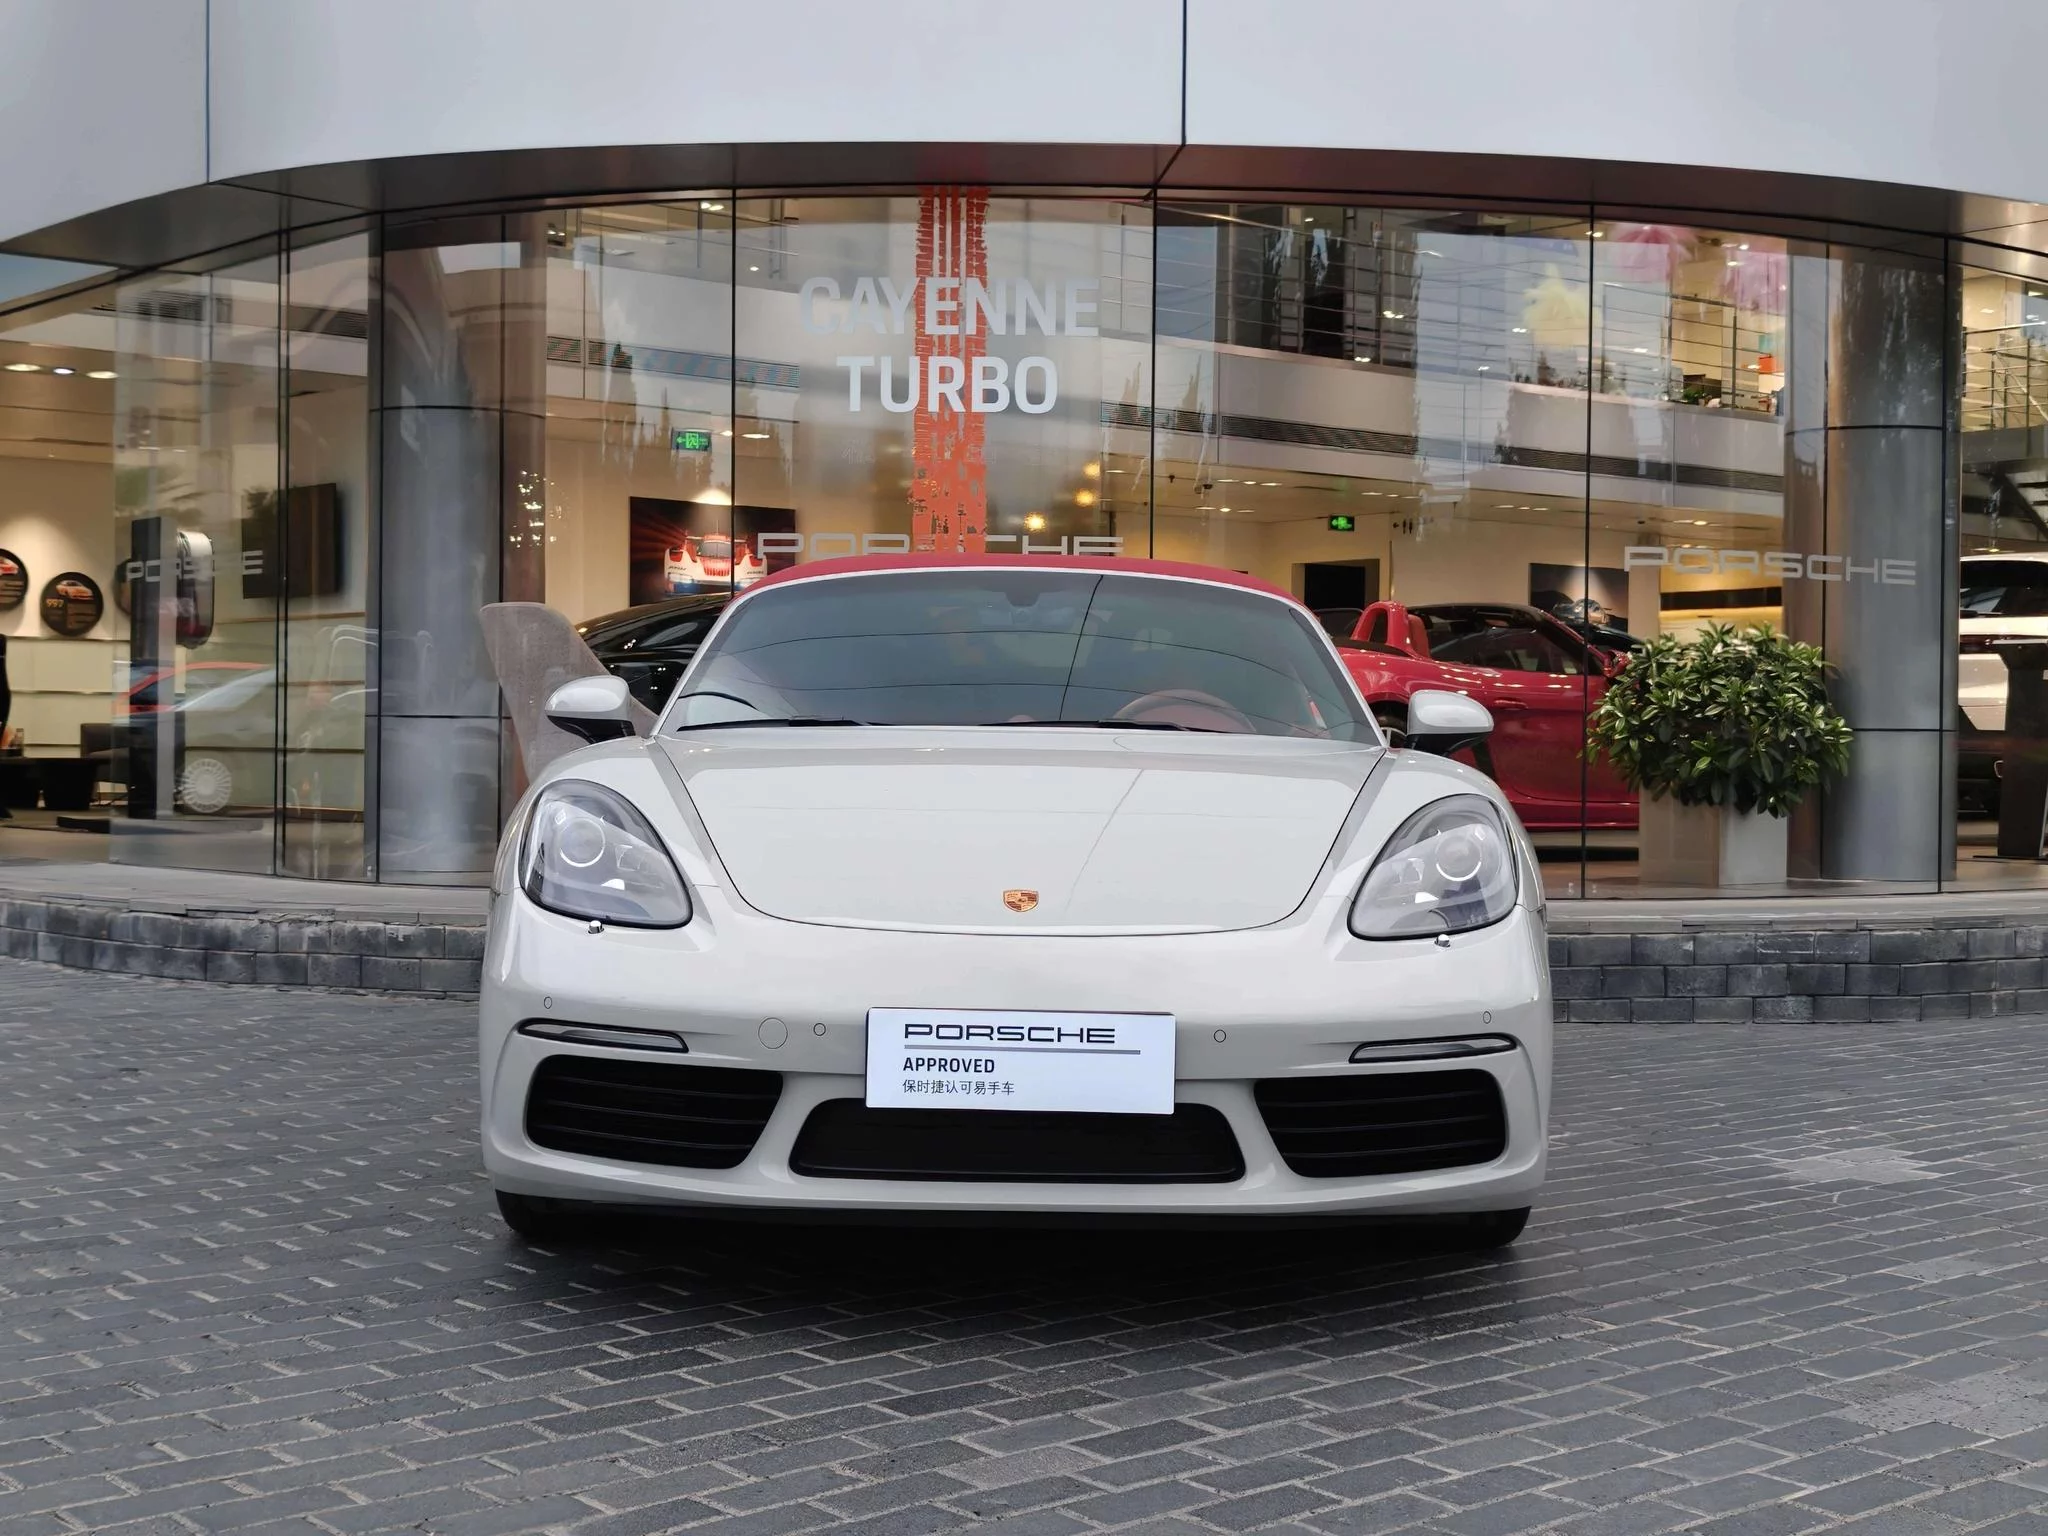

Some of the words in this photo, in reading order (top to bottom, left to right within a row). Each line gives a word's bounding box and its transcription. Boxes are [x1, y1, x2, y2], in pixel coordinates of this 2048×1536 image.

[800, 277, 1099, 336] CAYENNE
[837, 356, 1058, 413] TURBO
[758, 533, 1124, 560] PORHE
[1624, 545, 1917, 586] PORSCHE
[904, 1023, 1115, 1043] PORSCHE
[903, 1057, 995, 1073] APPROVED
[902, 1079, 1015, 1096] 保时捷认可易手车
